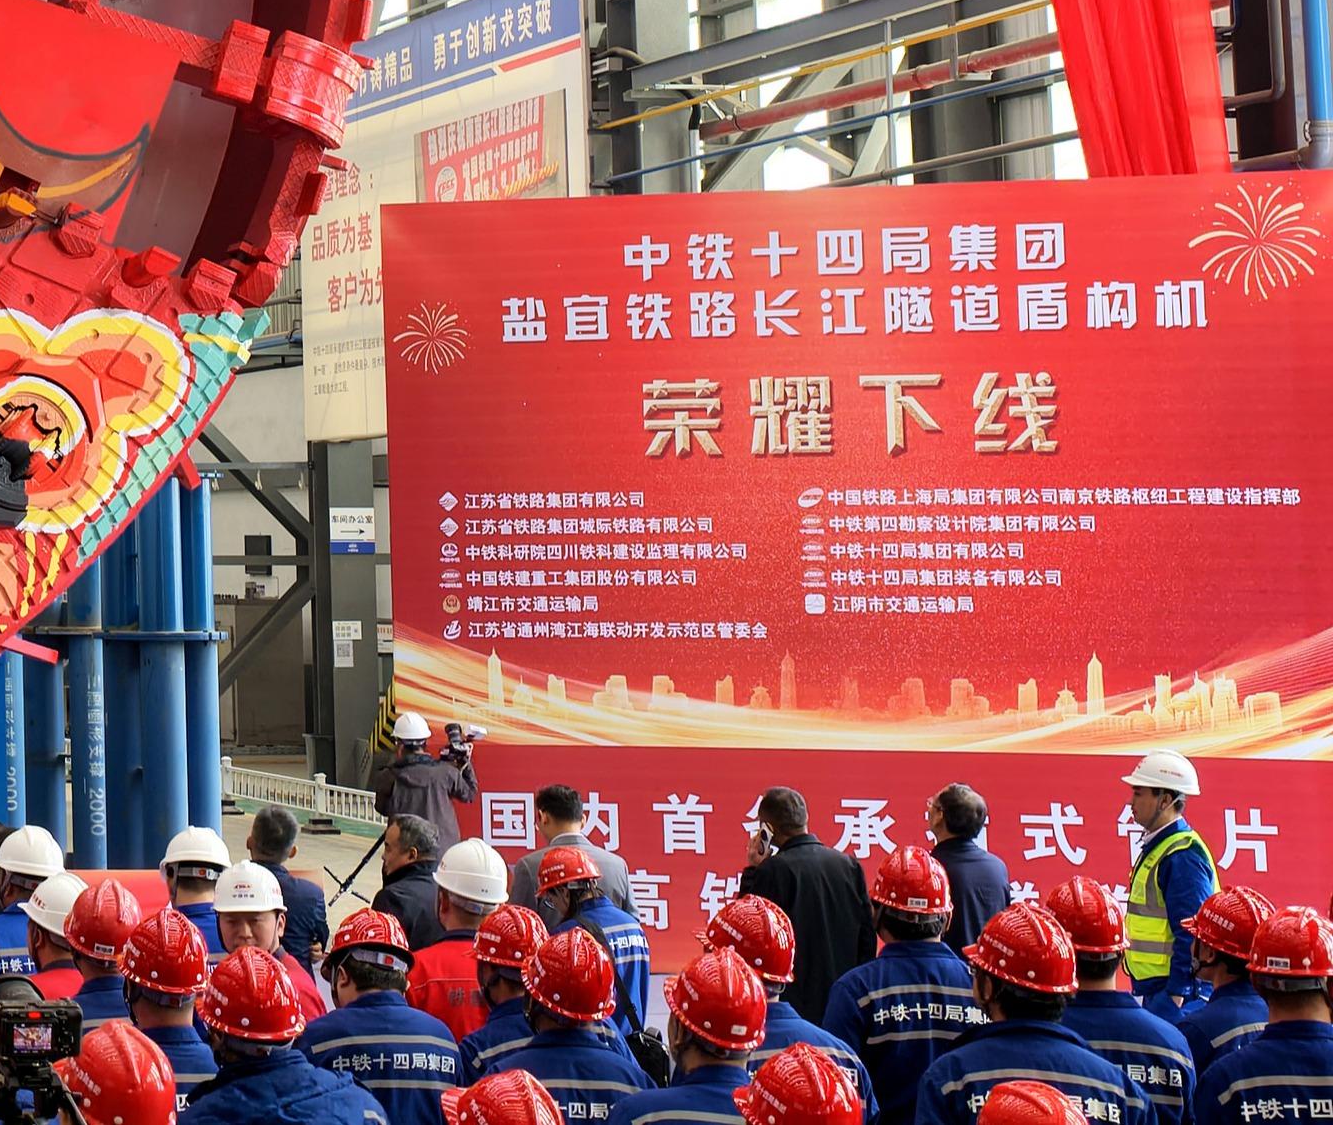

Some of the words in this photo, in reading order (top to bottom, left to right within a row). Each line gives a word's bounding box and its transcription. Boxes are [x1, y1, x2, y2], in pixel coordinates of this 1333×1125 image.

[311, 212, 373, 262] 品质为基
[621, 221, 1068, 282] 中铁十四局集团
[500, 279, 1209, 345] 盐宜铁路长江隧道盾构机
[641, 372, 1061, 459] 荣耀下线
[464, 492, 645, 509] 江苏省铁路集团有限公司
[827, 486, 1301, 507] 中国铁路上海局集团有限公司南京铁路枢纽工程建设指挥部
[332, 515, 373, 524] 车间办公室
[465, 517, 714, 535] 江苏省铁路集团城际铁路有限公司
[829, 514, 1096, 533] 中铁第四勘察设计院集团有限公司
[465, 543, 748, 561] 中铁科研院四川铁科建设监理有限公司
[830, 542, 1025, 560] 中铁十四局集团有限公司
[466, 569, 698, 587] 中国铁建重工集团股份有限公司
[831, 569, 1063, 587] 中铁十四局集团装备有限公司
[467, 595, 599, 613] 靖江市交通运输局
[833, 595, 974, 614] 江阴市交通运输局
[468, 621, 768, 640] 江苏省通州湾江海联动开发示范区管委会
[333, 1052, 456, 1074] 中铁十四局集团
[1114, 1063, 1183, 1087] 局集团
